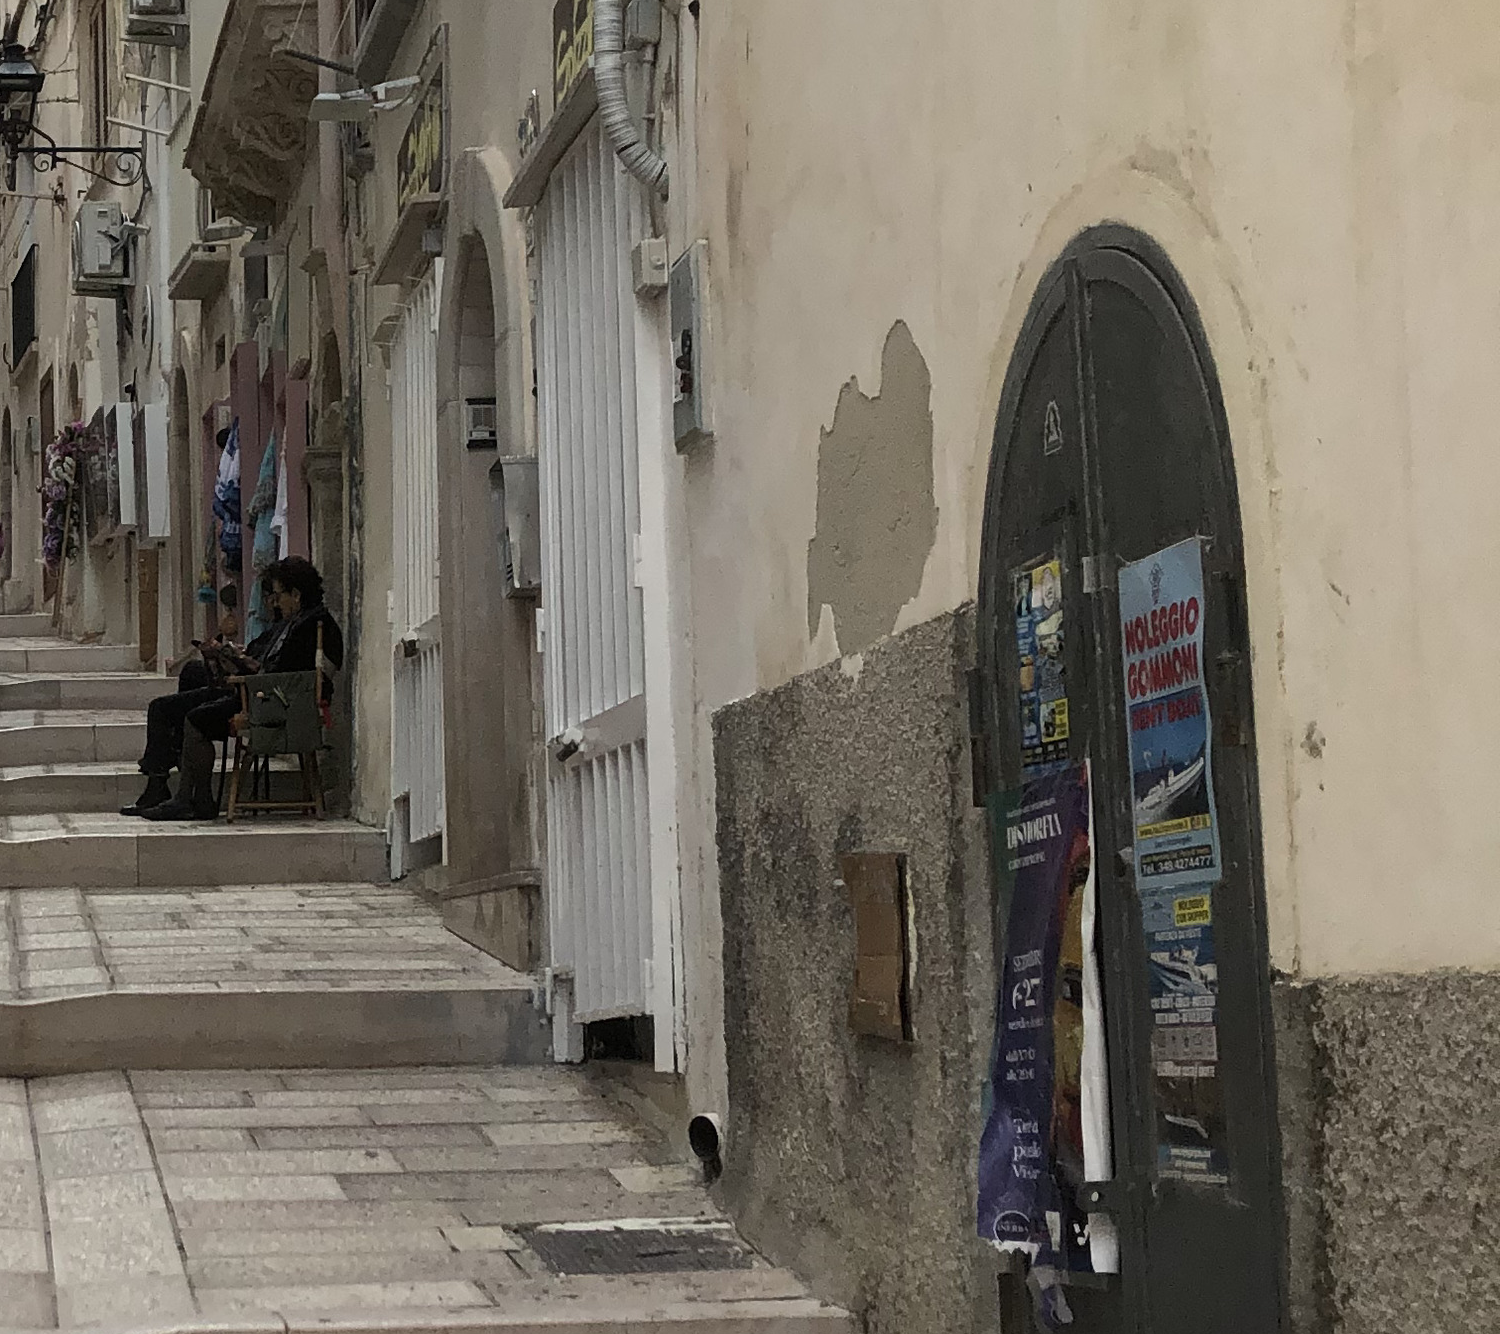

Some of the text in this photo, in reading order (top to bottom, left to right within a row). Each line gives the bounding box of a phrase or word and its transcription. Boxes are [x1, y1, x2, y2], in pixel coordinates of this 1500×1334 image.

[1124, 596, 1200, 656] NOLEGGIO
[1127, 641, 1199, 699] GOMMONI
[1132, 703, 1165, 732] RENT
